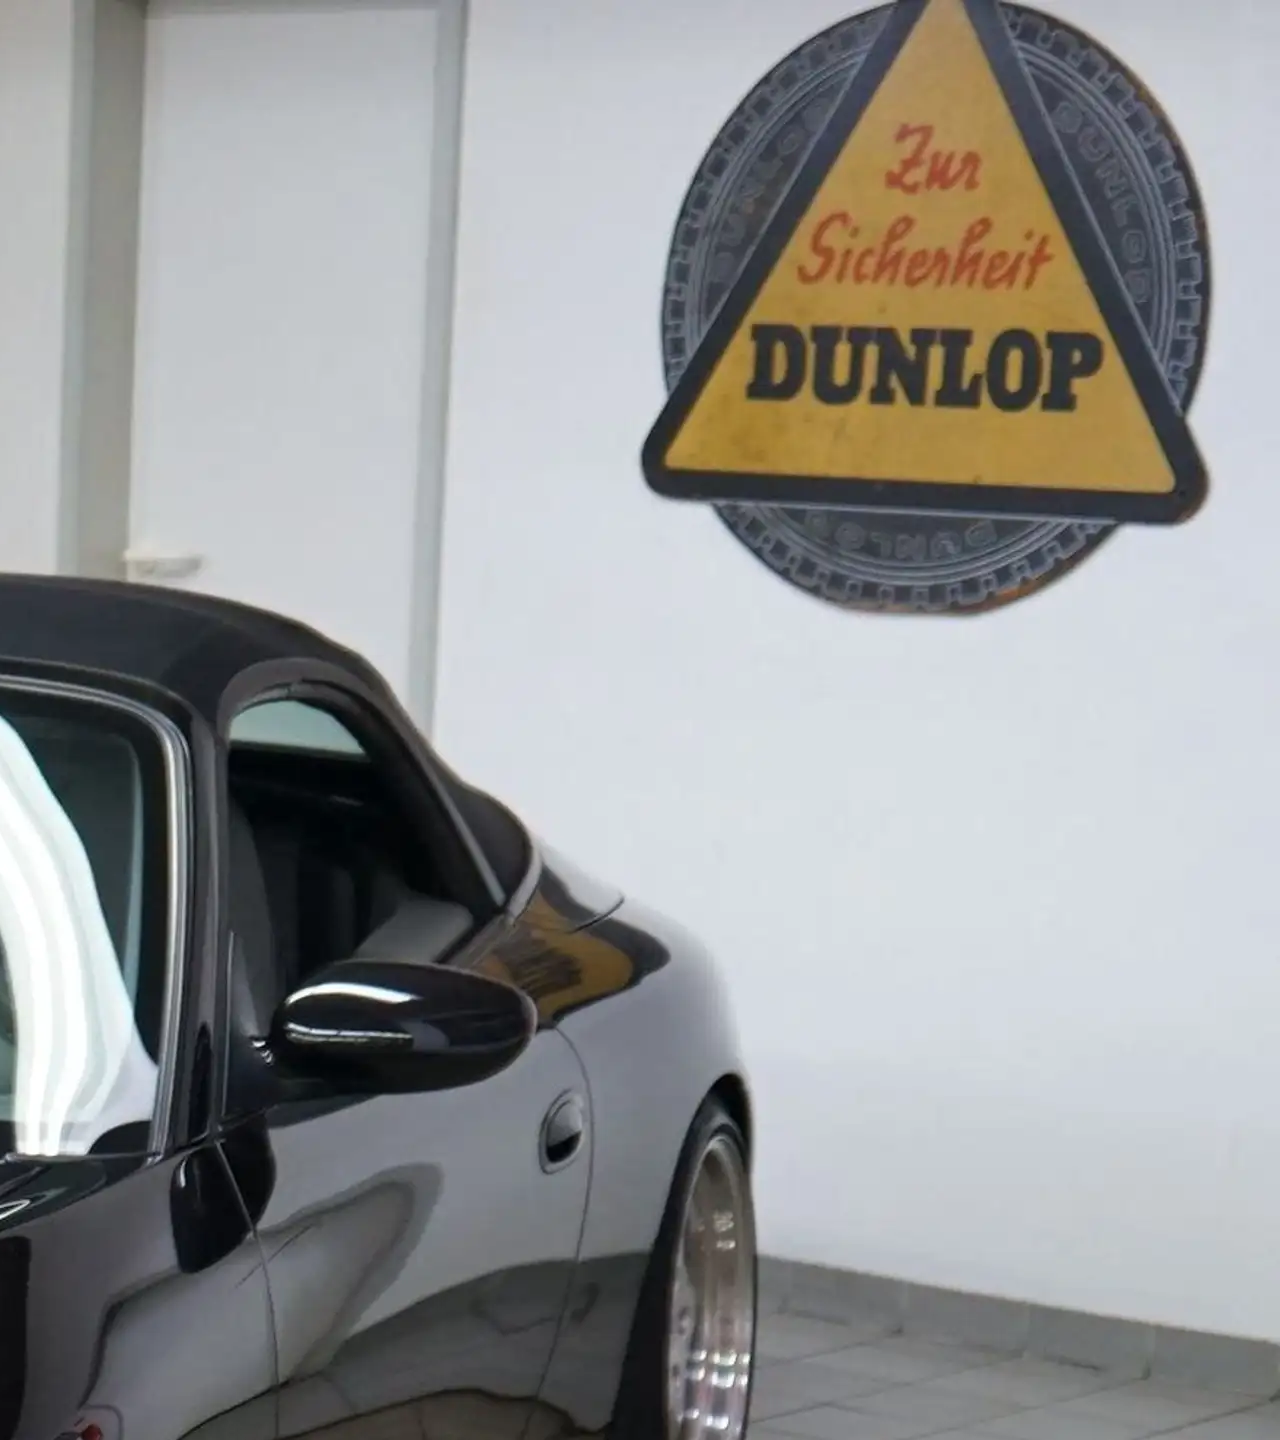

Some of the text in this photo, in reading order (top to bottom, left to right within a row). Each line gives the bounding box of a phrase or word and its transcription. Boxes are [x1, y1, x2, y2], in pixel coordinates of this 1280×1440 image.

[884, 122, 983, 196] Zur
[796, 210, 1057, 291] Sicherheit
[745, 322, 1105, 413] DUNLOP
